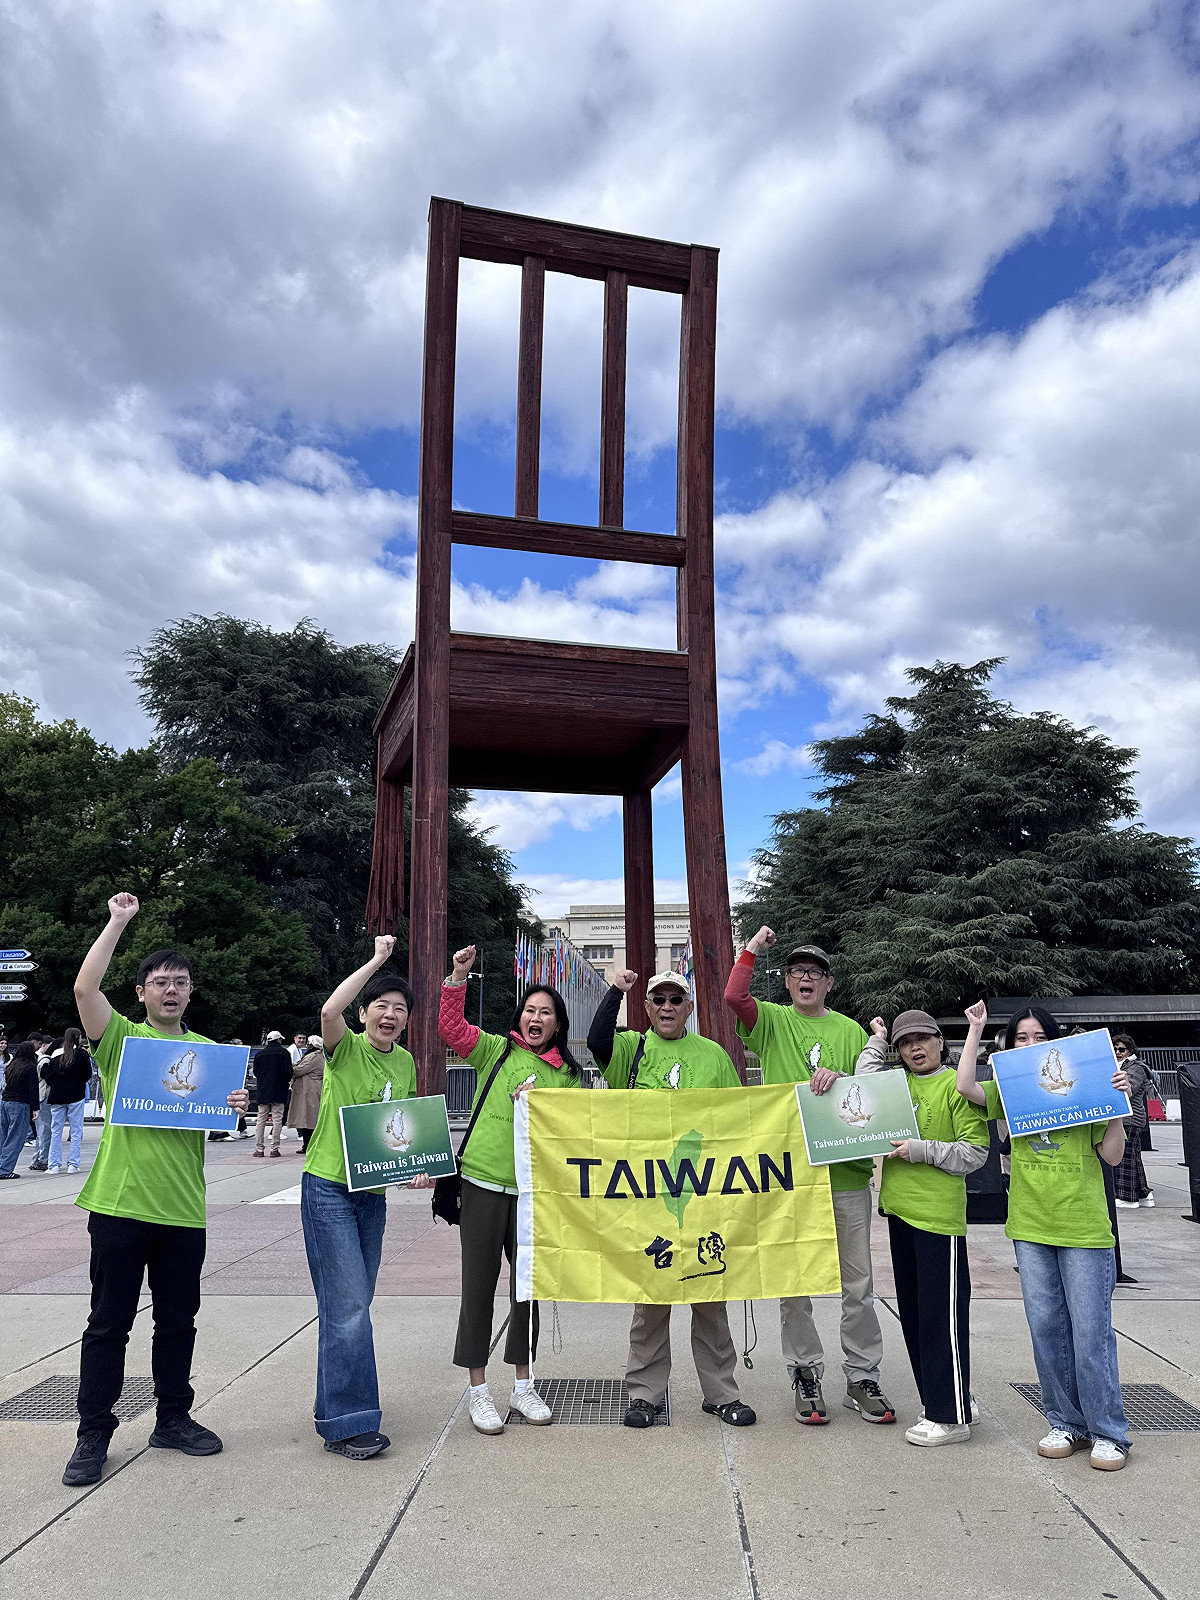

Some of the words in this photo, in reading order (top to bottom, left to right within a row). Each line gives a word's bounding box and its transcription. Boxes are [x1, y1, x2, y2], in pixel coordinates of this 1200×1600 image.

[628, 1072, 636, 1089] ONY
[121, 1097, 154, 1111] WHO
[155, 1101, 184, 1113] needs
[186, 1101, 233, 1116] Taiwan
[1015, 1115, 1058, 1131] TAIWAN
[1059, 1111, 1084, 1123] CAN
[1084, 1104, 1116, 1119] HELP.
[812, 1139, 844, 1149] Taiwan
[845, 1136, 858, 1145] for
[858, 1131, 885, 1142] Global
[885, 1127, 913, 1139] Health
[354, 1160, 397, 1175] Taiwan
[398, 1156, 409, 1168] is
[408, 1151, 449, 1166] Taiwan
[566, 1151, 794, 1199] TAIWAN
[644, 1231, 727, 1282] 台灣
